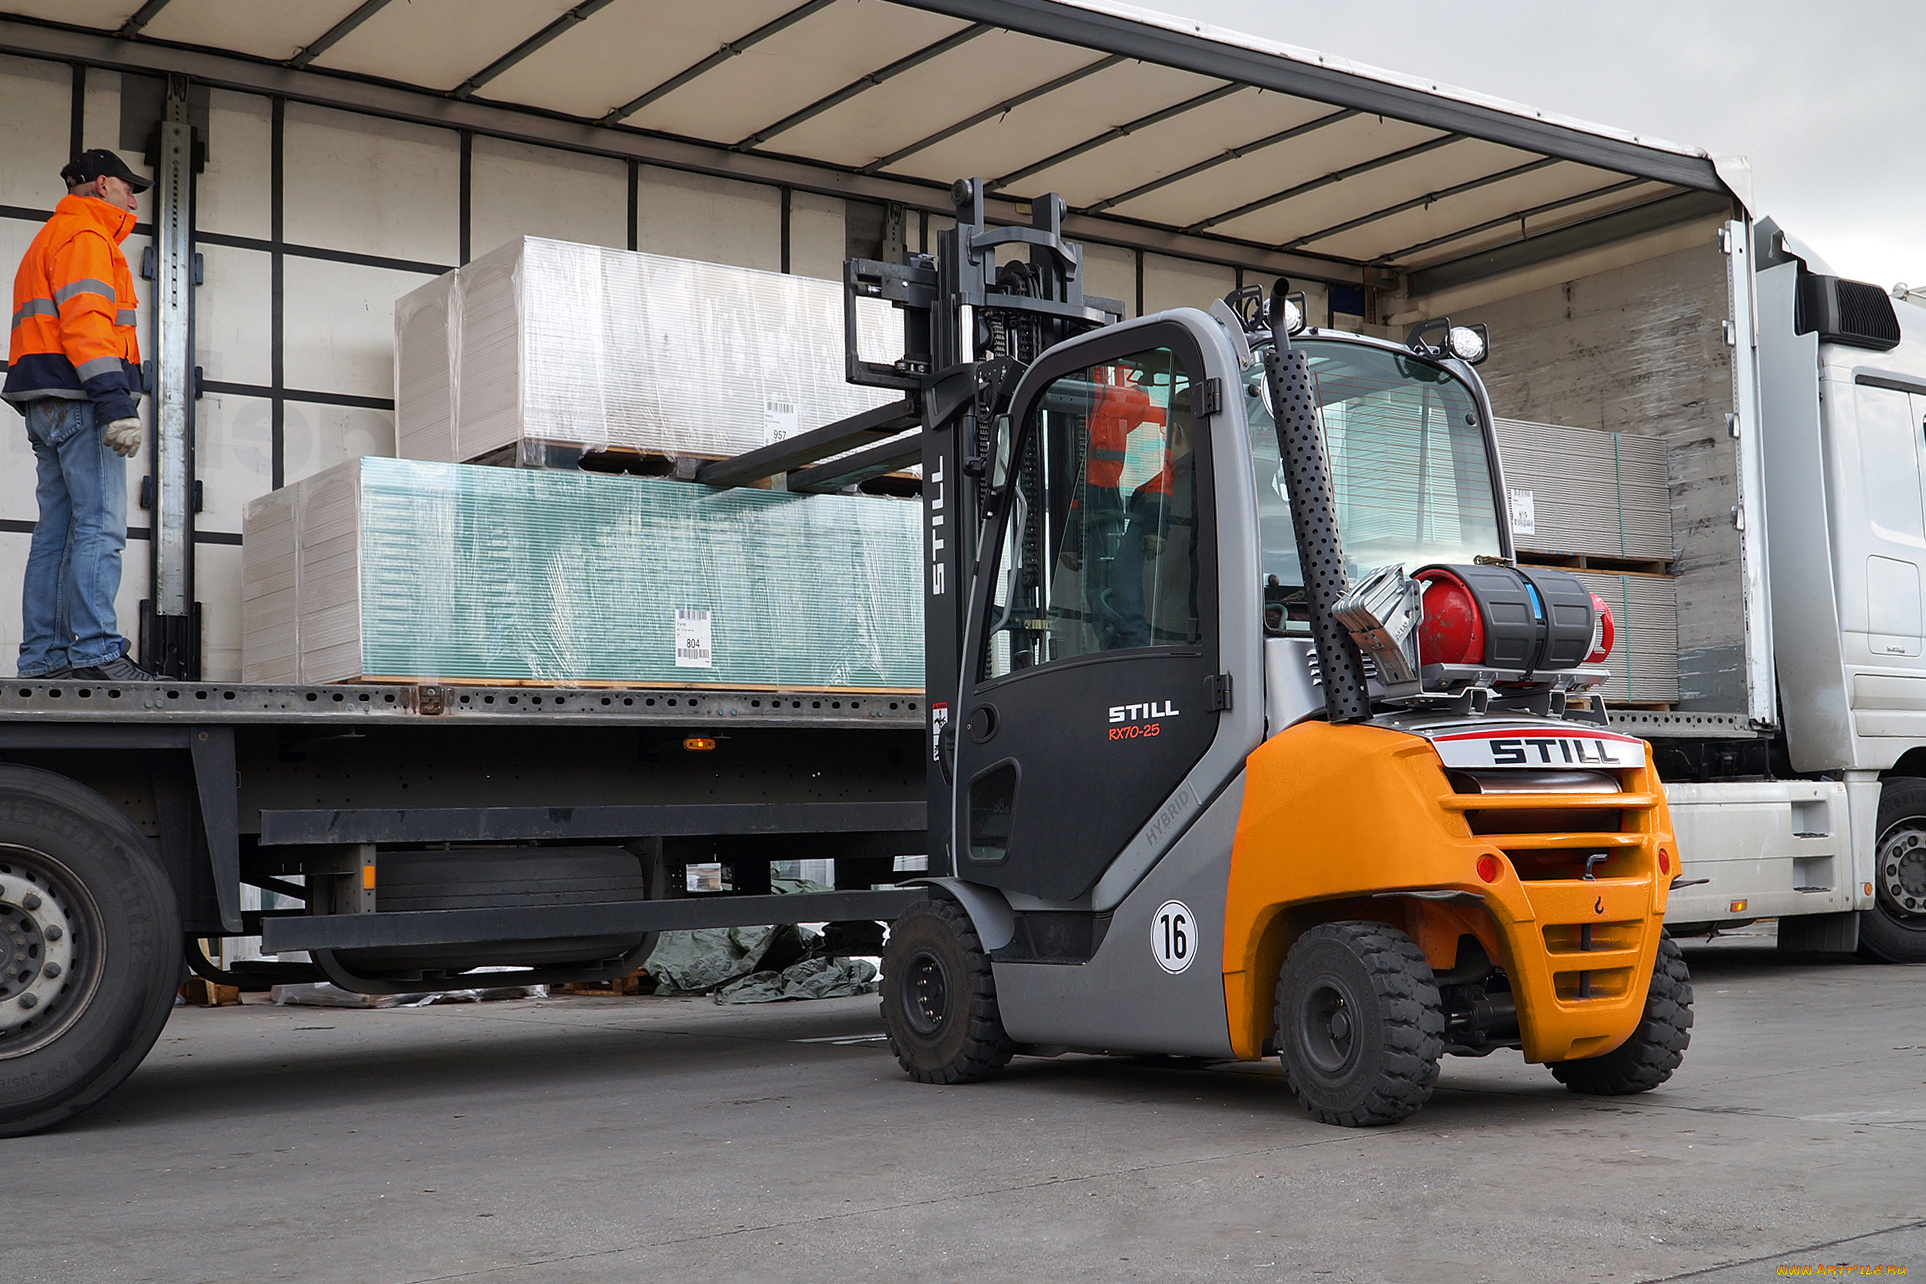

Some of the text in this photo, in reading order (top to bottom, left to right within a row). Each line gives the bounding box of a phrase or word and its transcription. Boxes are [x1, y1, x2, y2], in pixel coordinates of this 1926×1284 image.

[773, 429, 787, 440] 957
[931, 455, 945, 596] STILL
[686, 638, 700, 649] 804
[1108, 699, 1180, 724] STILL
[1108, 722, 1161, 741] RX70-25
[1488, 738, 1621, 765] STILL
[1145, 789, 1189, 846] HYBRID
[1160, 913, 1188, 960] 16
